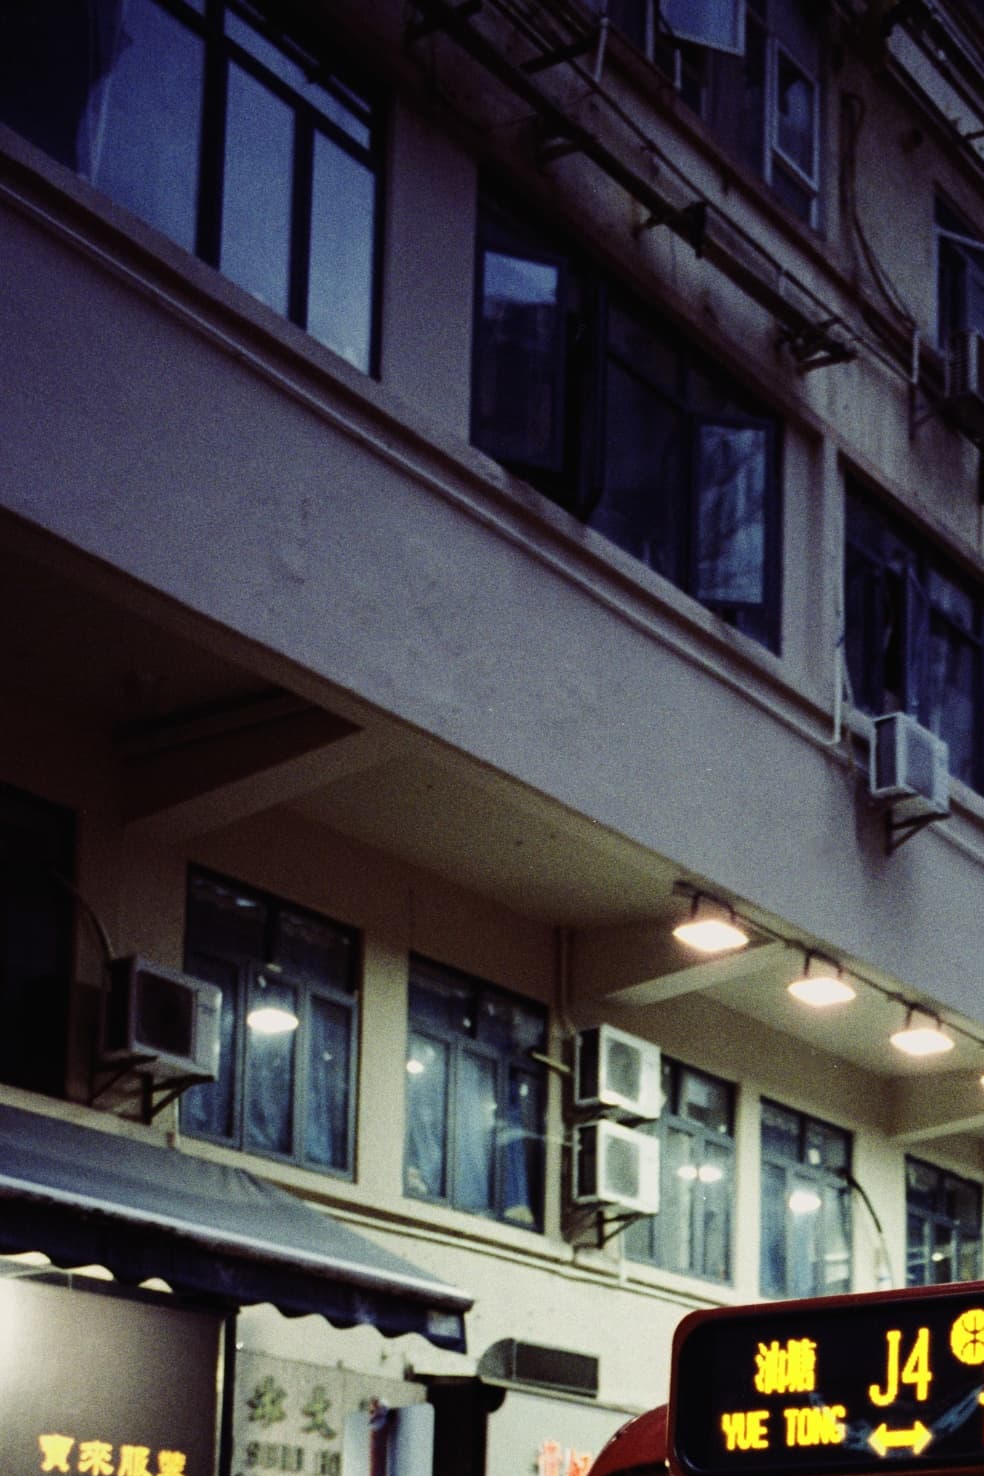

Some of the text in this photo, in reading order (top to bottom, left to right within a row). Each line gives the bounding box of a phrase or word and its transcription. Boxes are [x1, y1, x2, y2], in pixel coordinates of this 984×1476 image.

[870, 1328, 932, 1406] J4
[721, 1405, 847, 1451] YUE TONG
